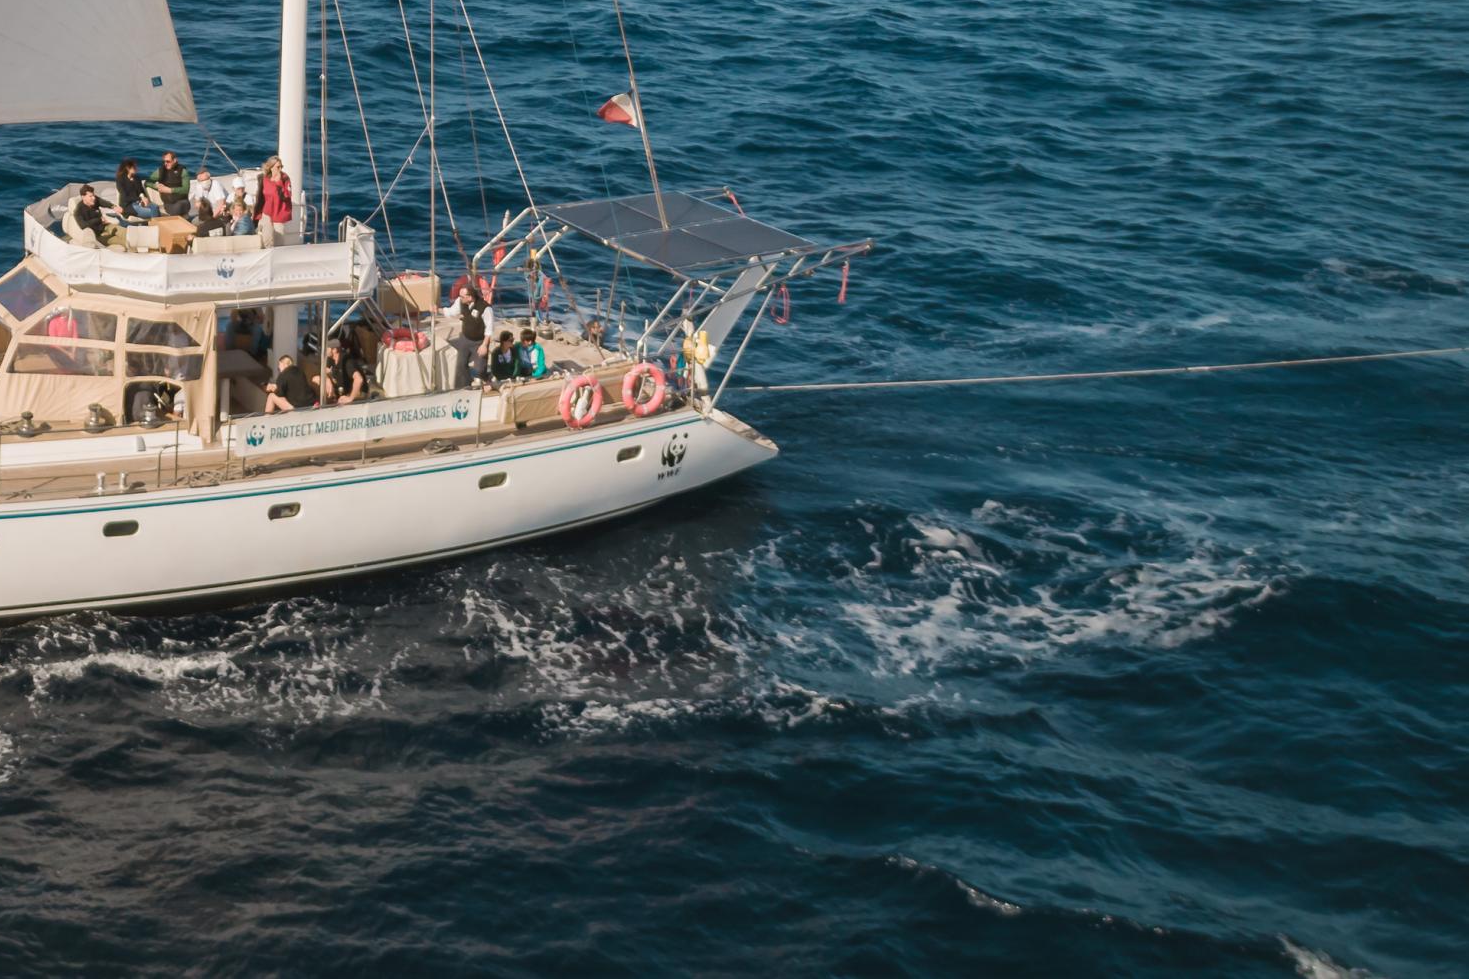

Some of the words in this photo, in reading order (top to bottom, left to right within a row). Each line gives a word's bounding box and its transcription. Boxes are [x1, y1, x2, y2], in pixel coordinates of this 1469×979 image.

[270, 422, 313, 440] PROTECT
[315, 414, 393, 433] MEDITERRANEAN
[397, 405, 446, 423] TREASURES
